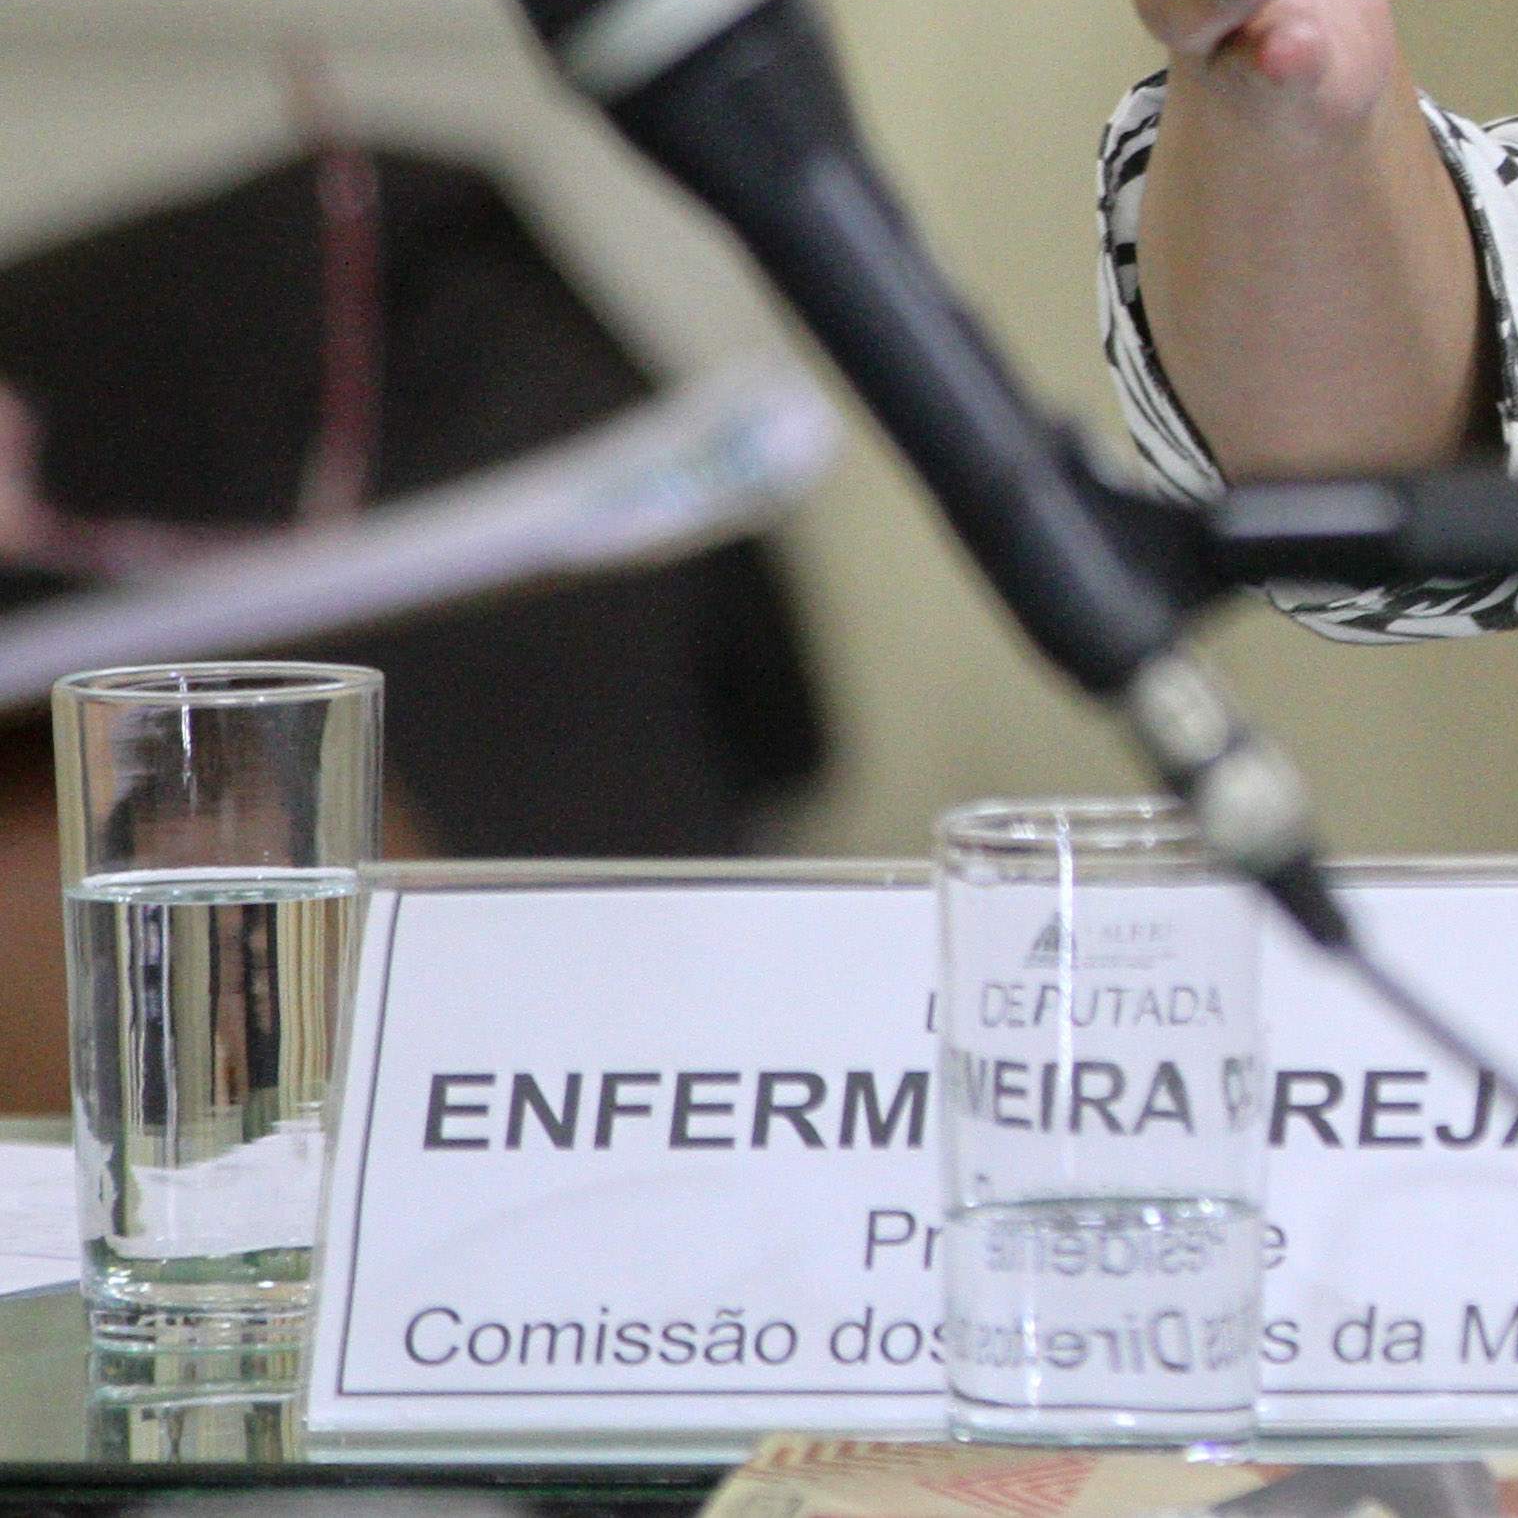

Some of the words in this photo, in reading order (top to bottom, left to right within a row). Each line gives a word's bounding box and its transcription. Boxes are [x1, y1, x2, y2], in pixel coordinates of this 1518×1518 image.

[979, 982, 1226, 1030] DEPUTADA
[403, 1307, 799, 1367] Comissão
[1331, 1304, 1425, 1366] da
